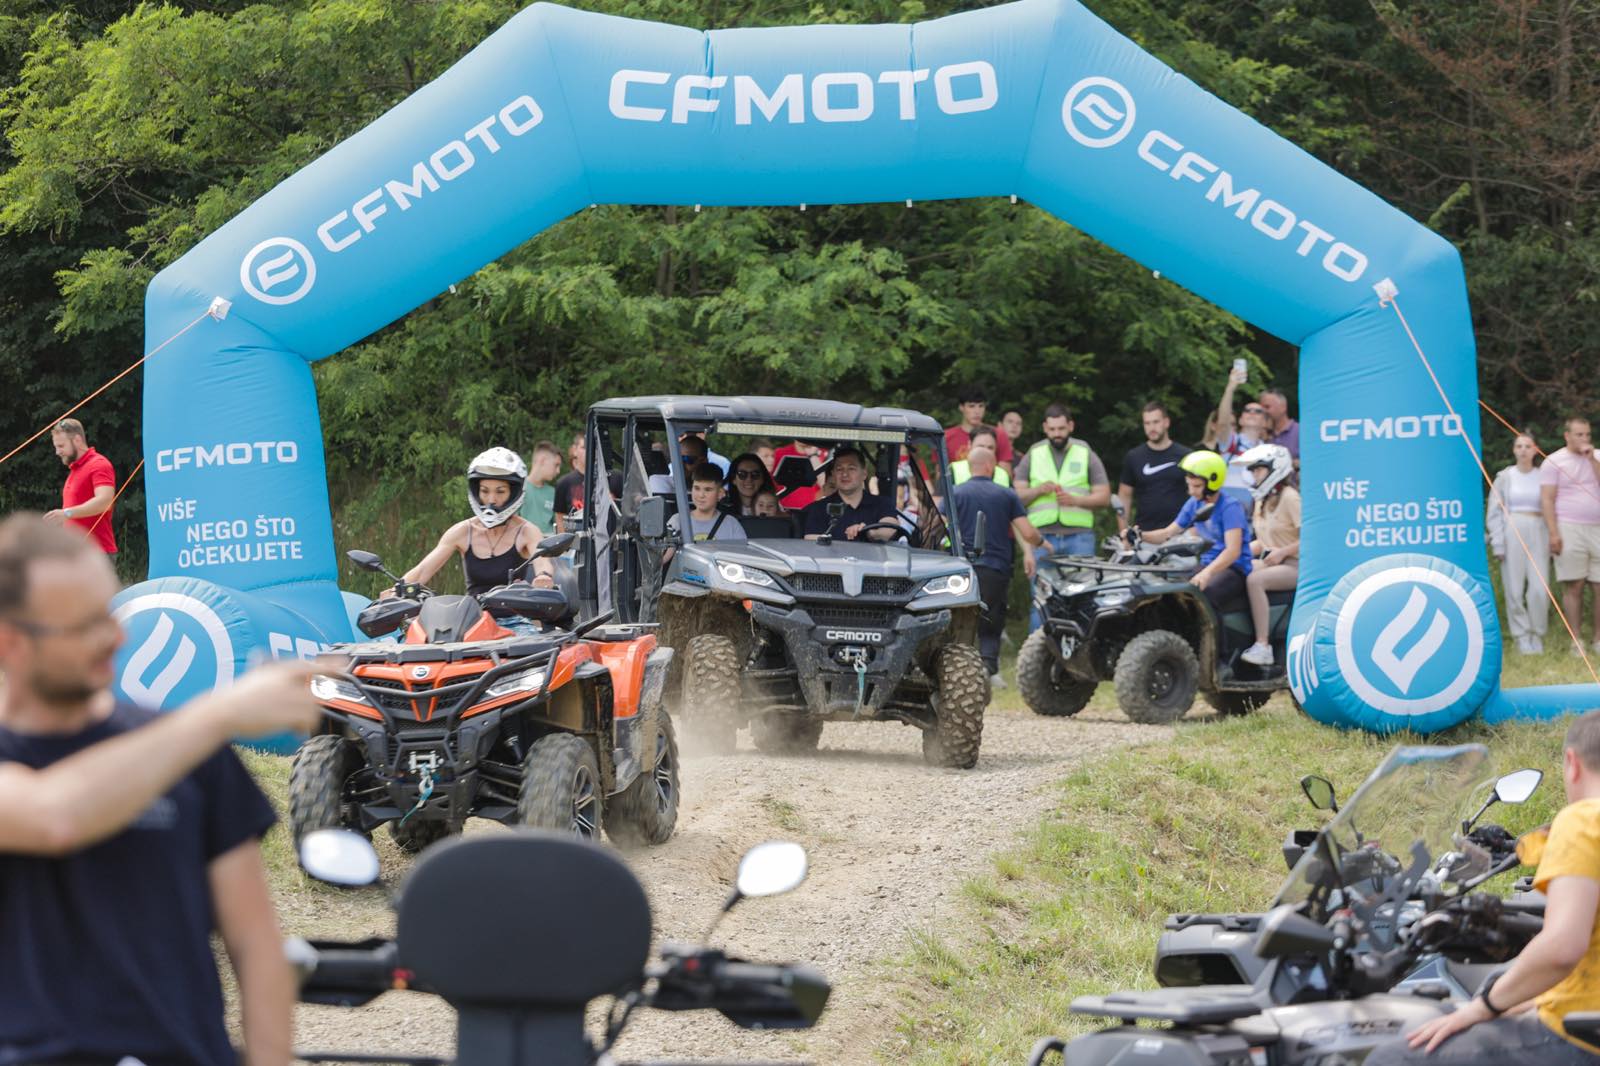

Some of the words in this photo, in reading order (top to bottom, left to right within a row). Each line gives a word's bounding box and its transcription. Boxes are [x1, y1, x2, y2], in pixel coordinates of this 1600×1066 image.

[608, 60, 998, 125] CFMOTO
[316, 95, 544, 253] CFMOTO
[1137, 129, 1369, 282] CFMOTO
[1320, 414, 1463, 442] CFMOTO
[156, 441, 298, 472] CFMOTO
[1323, 478, 1370, 500] VIŠE
[158, 497, 197, 522] VIŠE
[1356, 502, 1420, 524] NEGO
[1425, 496, 1462, 520] ŠTO
[186, 520, 248, 543] NEGO
[255, 514, 296, 537] ŠTO
[1345, 523, 1467, 548] OČEKUJETE
[178, 540, 303, 568] OČEKUJETE
[826, 630, 882, 641] CFMOTO
